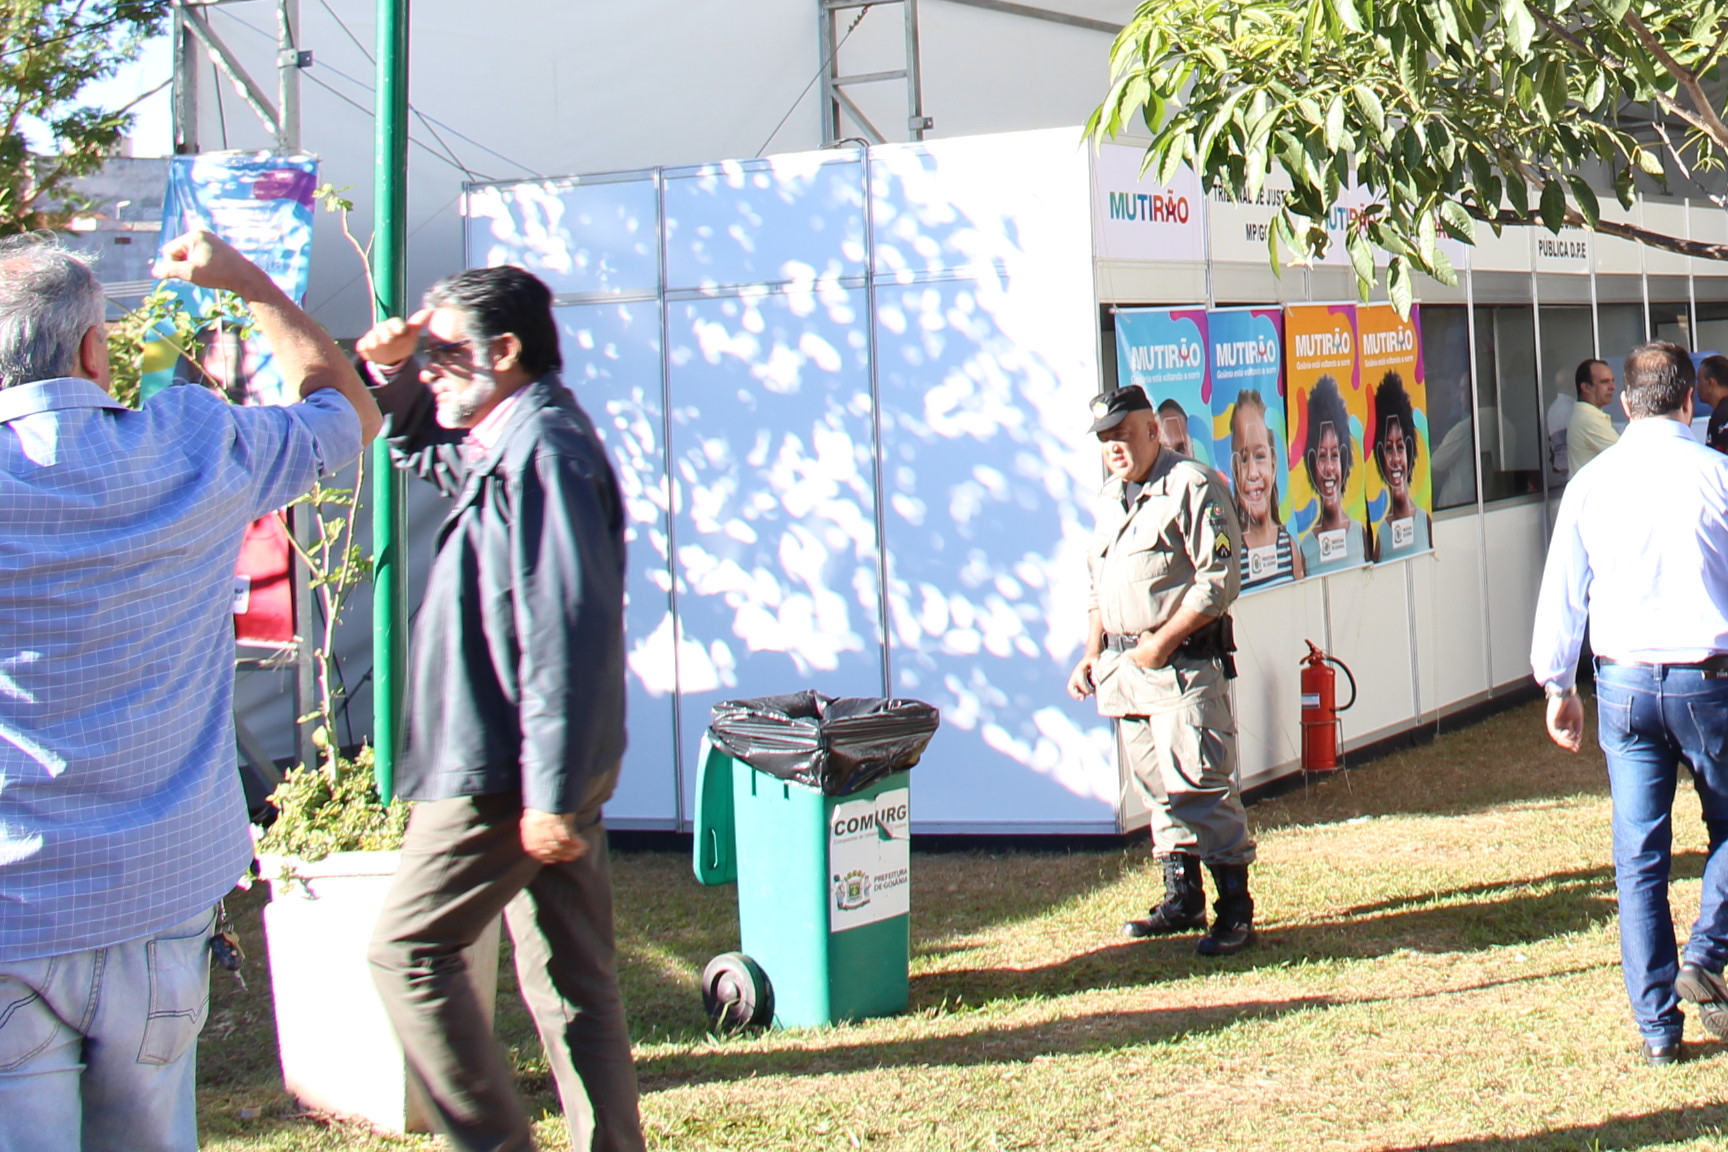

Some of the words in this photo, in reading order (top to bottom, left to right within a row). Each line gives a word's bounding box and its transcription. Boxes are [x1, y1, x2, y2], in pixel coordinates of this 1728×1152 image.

[1109, 189, 1189, 224] MUTIRÃO
[1538, 235, 1569, 258] PÚBLICA
[1131, 338, 1200, 371] MUTIRÃO
[1216, 335, 1276, 367] MUTIRÃO
[1295, 328, 1350, 357] MUTIRÃO
[1363, 325, 1413, 356] MUTIRÃO
[834, 804, 907, 837] COMURG
